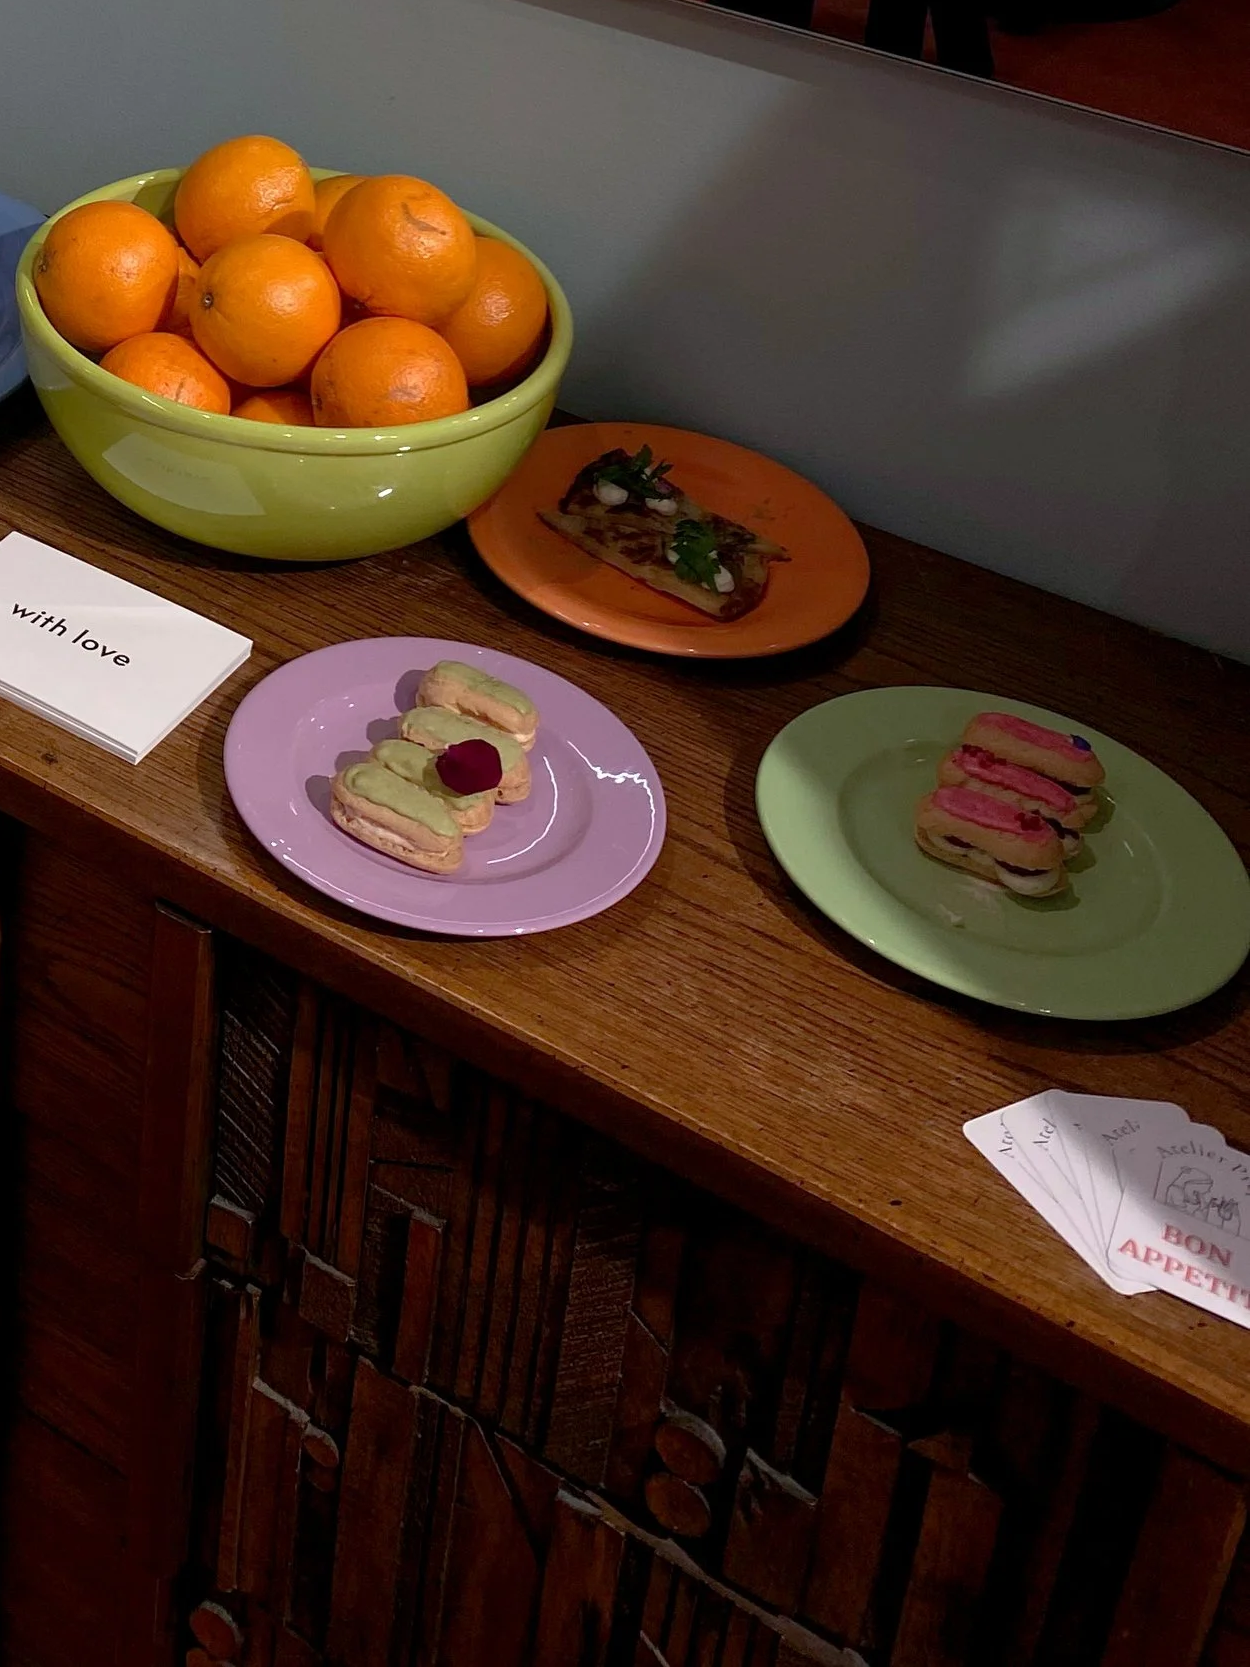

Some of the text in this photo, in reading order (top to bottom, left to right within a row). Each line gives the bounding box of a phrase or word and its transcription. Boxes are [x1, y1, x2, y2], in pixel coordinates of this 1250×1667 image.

[12, 603, 130, 666] with love
[1156, 1140, 1228, 1163] Atelier
[1161, 1223, 1231, 1267] BON
